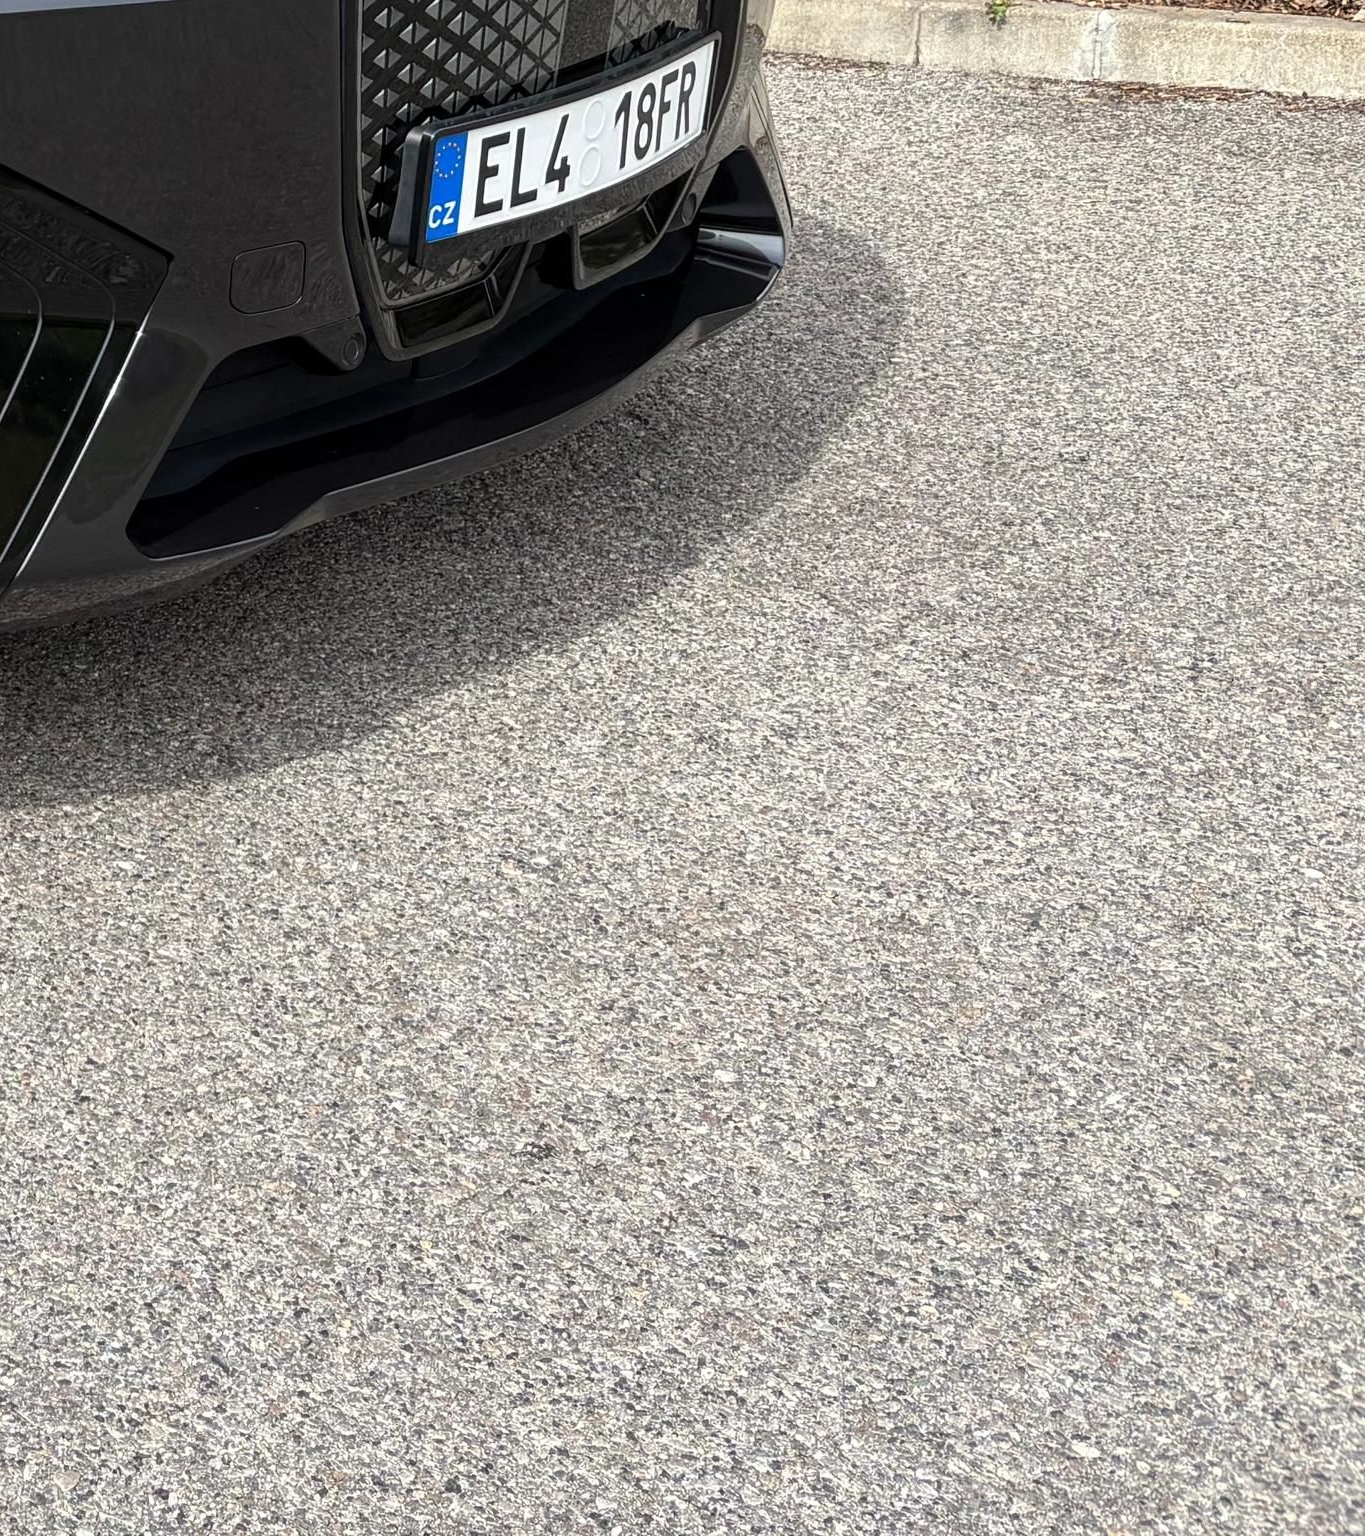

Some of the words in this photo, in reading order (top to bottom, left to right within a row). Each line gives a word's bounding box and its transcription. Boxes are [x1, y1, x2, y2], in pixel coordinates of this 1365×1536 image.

[474, 113, 571, 218] EL4
[614, 61, 697, 170] 18FR
[428, 200, 457, 229] CZ
